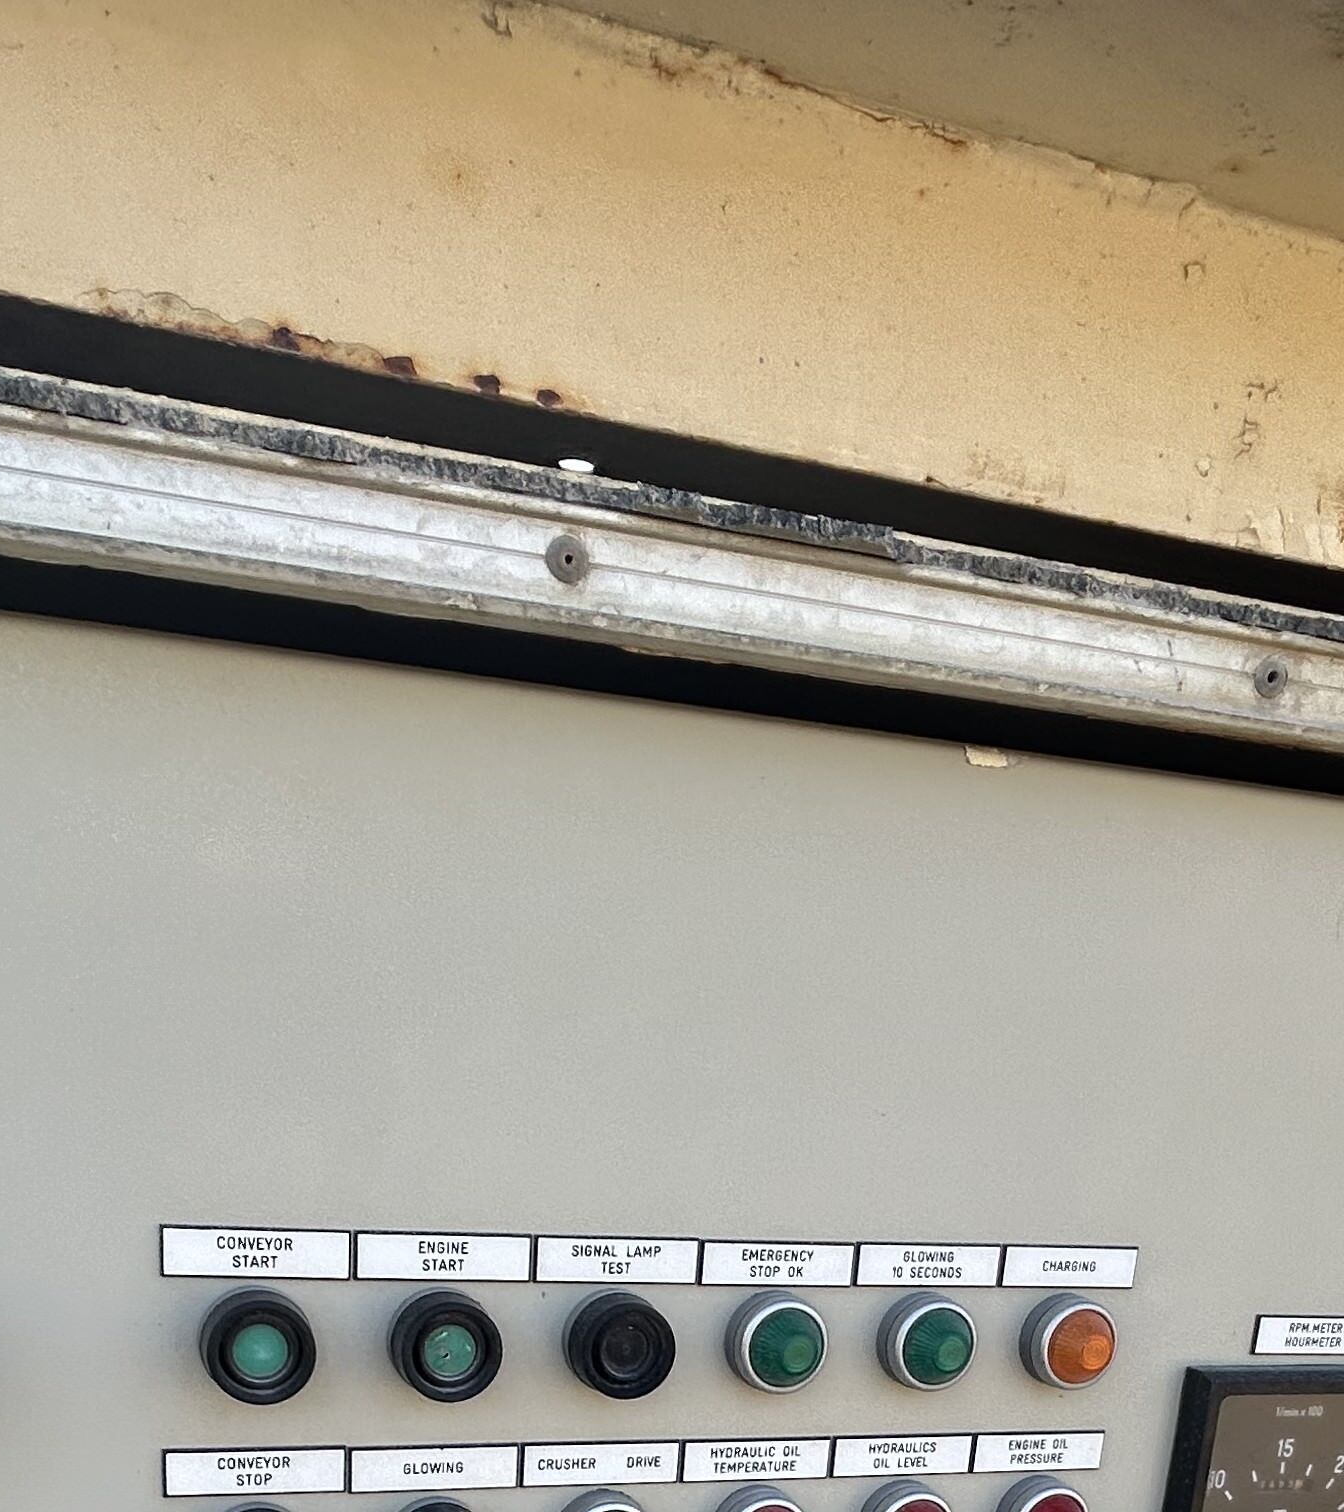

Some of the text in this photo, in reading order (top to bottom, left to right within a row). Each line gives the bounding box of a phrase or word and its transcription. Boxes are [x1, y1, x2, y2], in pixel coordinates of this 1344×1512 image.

[216, 1235, 293, 1252] CONVEYOR
[418, 1240, 469, 1255] ENGINE
[571, 1244, 662, 1258] SIGNAL LAMP
[741, 1248, 814, 1262] EMERGENCY
[903, 1251, 955, 1263] GLOWING
[232, 1254, 278, 1269] START
[422, 1258, 464, 1272] START
[601, 1261, 631, 1275] TEST
[1042, 1260, 1097, 1273] CHARGING
[749, 1265, 804, 1278] STOP OK
[892, 1267, 963, 1279] 10 SECONDS
[1284, 1335, 1342, 1348] HOURMETER
[868, 1441, 937, 1455] HYDRAULICS
[1008, 1438, 1069, 1451] ENGINE OIL
[1277, 1438, 1295, 1457] 15
[710, 1444, 801, 1460] HYDRAULIC OIL
[1010, 1452, 1064, 1465] PRESSURE
[217, 1456, 291, 1471] CONVEYOR
[403, 1461, 464, 1476] GLOWING
[537, 1455, 662, 1471] CRUSHER DRIVE
[713, 1460, 797, 1474] TEMPERATURE
[873, 1456, 928, 1470] OIL LEVEL
[236, 1472, 273, 1487] STOP
[1208, 1469, 1226, 1489] 10
